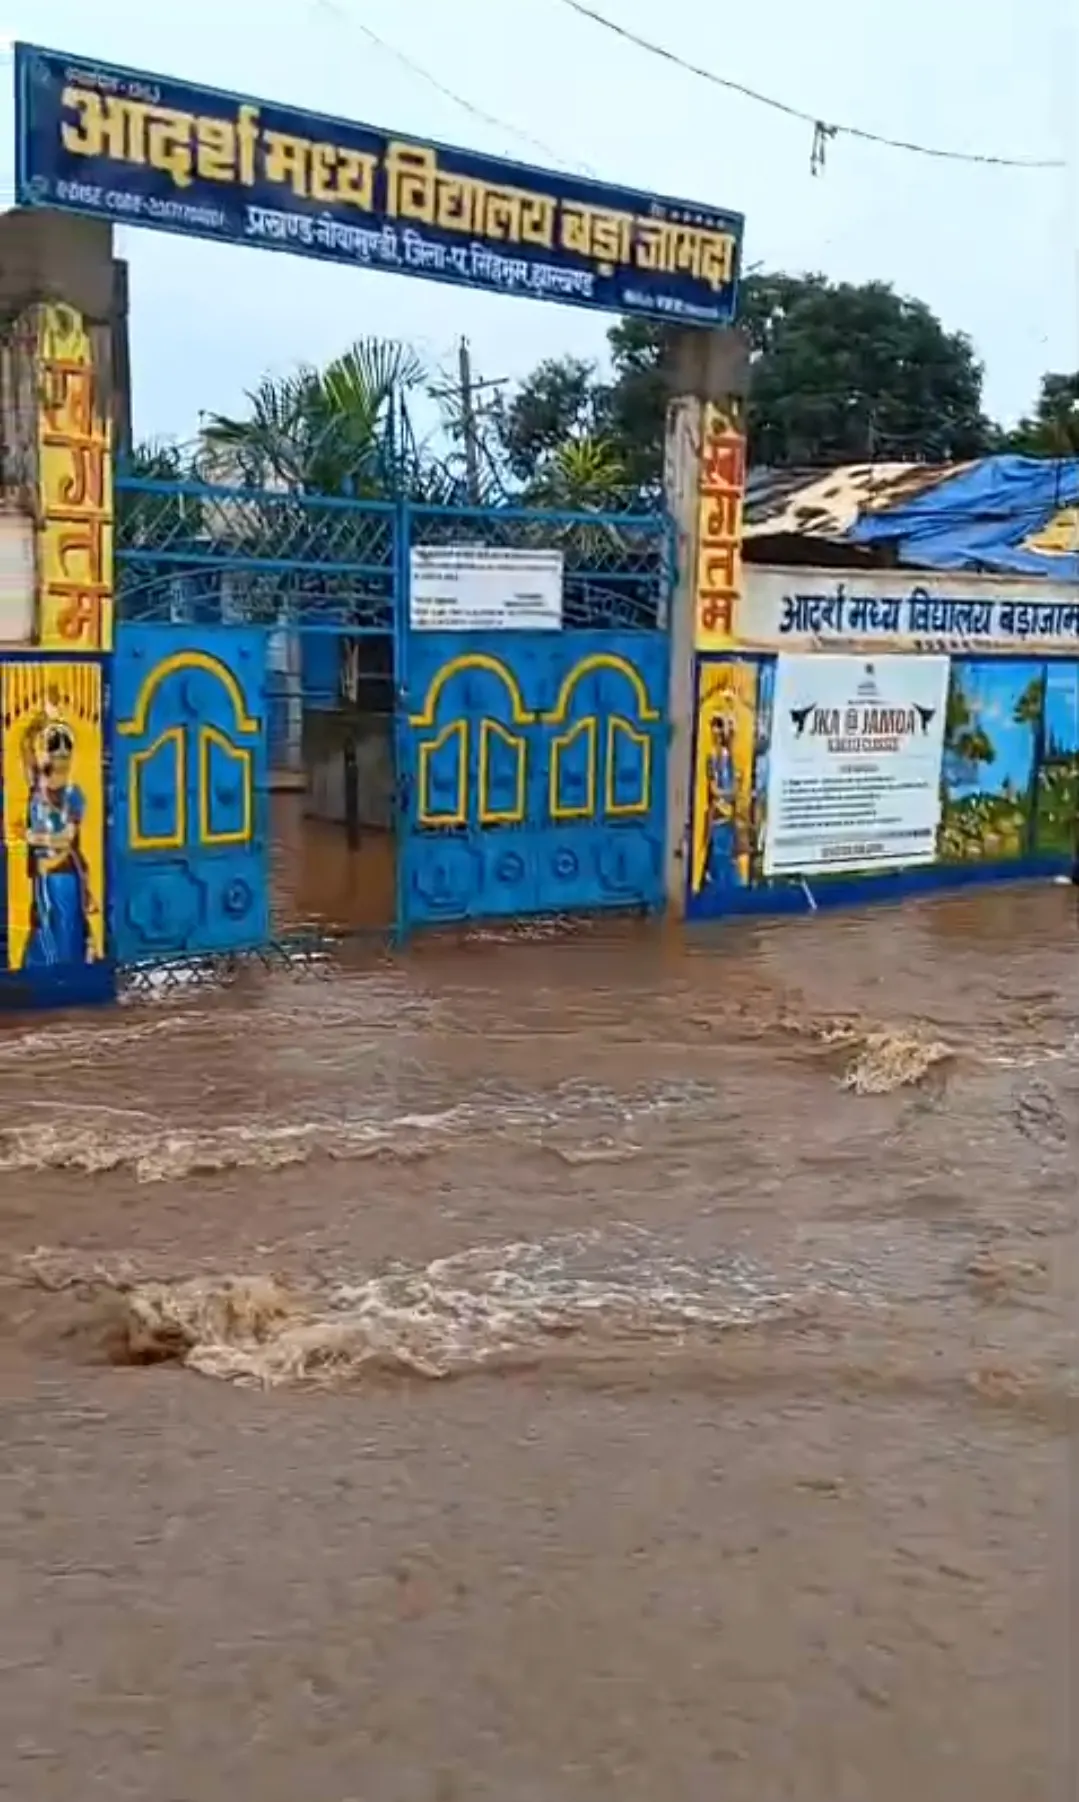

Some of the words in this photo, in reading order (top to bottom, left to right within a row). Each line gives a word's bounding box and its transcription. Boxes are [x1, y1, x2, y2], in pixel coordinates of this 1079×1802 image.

[61, 86, 260, 188] आदर्श
[264, 130, 378, 212] मध्य
[386, 141, 556, 248] विद्यालय
[560, 200, 634, 277] बड़ा
[634, 217, 736, 291] जामदा
[779, 584, 845, 640] आदर्श
[849, 596, 903, 633] मध्य
[907, 587, 994, 636] विद्यालय
